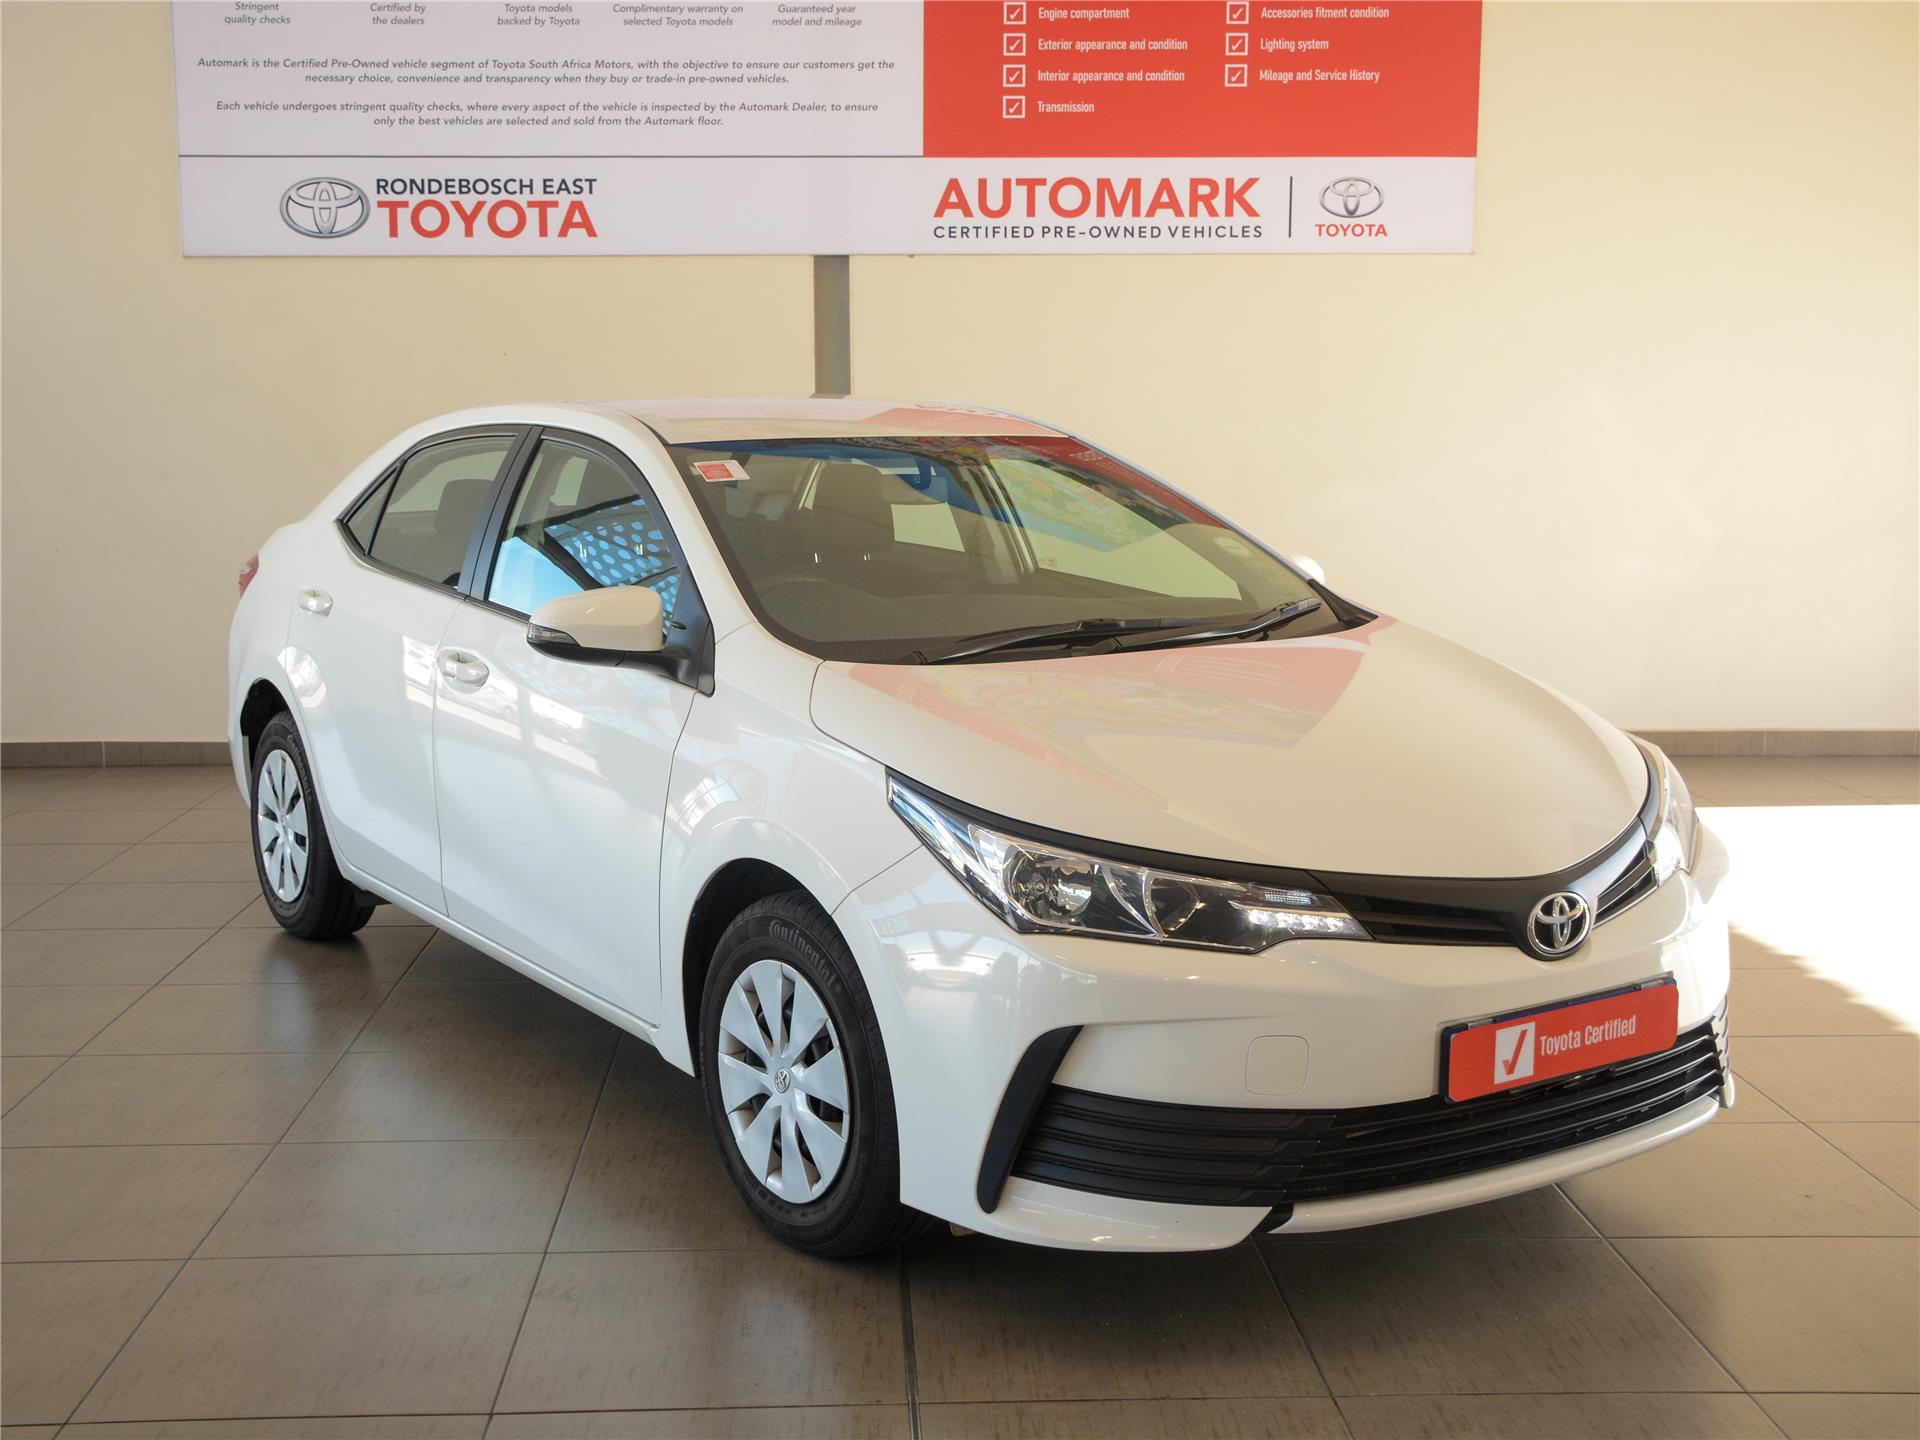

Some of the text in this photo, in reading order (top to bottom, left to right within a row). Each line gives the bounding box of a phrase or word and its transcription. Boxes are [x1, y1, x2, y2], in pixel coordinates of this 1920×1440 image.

[234, 2, 280, 13] Stringent
[369, 3, 427, 14] Certified by
[504, 3, 573, 14] Toyota models
[612, 4, 744, 15] Complimentary warranty on
[777, 4, 857, 16] Guaranteed year
[1260, 7, 1390, 18] Accessories fitment condition
[223, 14, 291, 26] quality checks
[371, 15, 425, 25] the dealers
[1038, 7, 1130, 21] Engine compartment
[496, 16, 581, 27] backed by Toyota
[623, 16, 734, 28] selected Toyota models
[771, 16, 863, 28] model and mileage
[1037, 39, 1188, 52] Exterior appearance and condition
[1260, 38, 1330, 52] Lighting system
[196, 56, 249, 67] Automark
[251, 58, 261, 68] is
[262, 58, 281, 68] the
[282, 58, 329, 68] Certified
[330, 59, 390, 68] Pre-Owned
[391, 59, 428, 68] vehicle
[430, 61, 476, 71] segment
[477, 59, 490, 68] of
[491, 59, 526, 71] Toyota
[528, 59, 559, 69] South
[561, 59, 592, 68] Africa
[594, 60, 634, 69] Motors,
[636, 60, 660, 69] with
[662, 60, 680, 69] the
[681, 60, 730, 71] objective
[731, 60, 743, 69] to
[745, 62, 780, 70] ensure
[802, 60, 855, 70] customers
[857, 62, 876, 71] get
[878, 60, 895, 69] the
[304, 73, 790, 85] necessary choice, convenience and transparency when they buy or trade-in pre-owned vehicles.
[1037, 70, 1185, 84] Interior appearance and condition
[1259, 69, 1381, 83] Mileage and Service History
[215, 101, 879, 113] Each vehicle undergoes stringent quality checks, where every aspect of the vehicle is inspected by the Automark Dealer, to ensure
[1037, 101, 1095, 112] Transmission
[373, 116, 724, 128] only the best vehicles are selected and sold from the Automark floor.
[376, 178, 597, 195] RONDEBOSCH EAST
[934, 177, 1259, 219] AUTOMARK
[377, 199, 597, 239] TOYOTA
[933, 226, 1263, 238] CERTIFIED PRE-OWNED VEHICLES
[1314, 223, 1390, 238] TOYOTA
[768, 919, 837, 988] Continental
[1540, 1015, 1636, 1056] Toyota Certified
